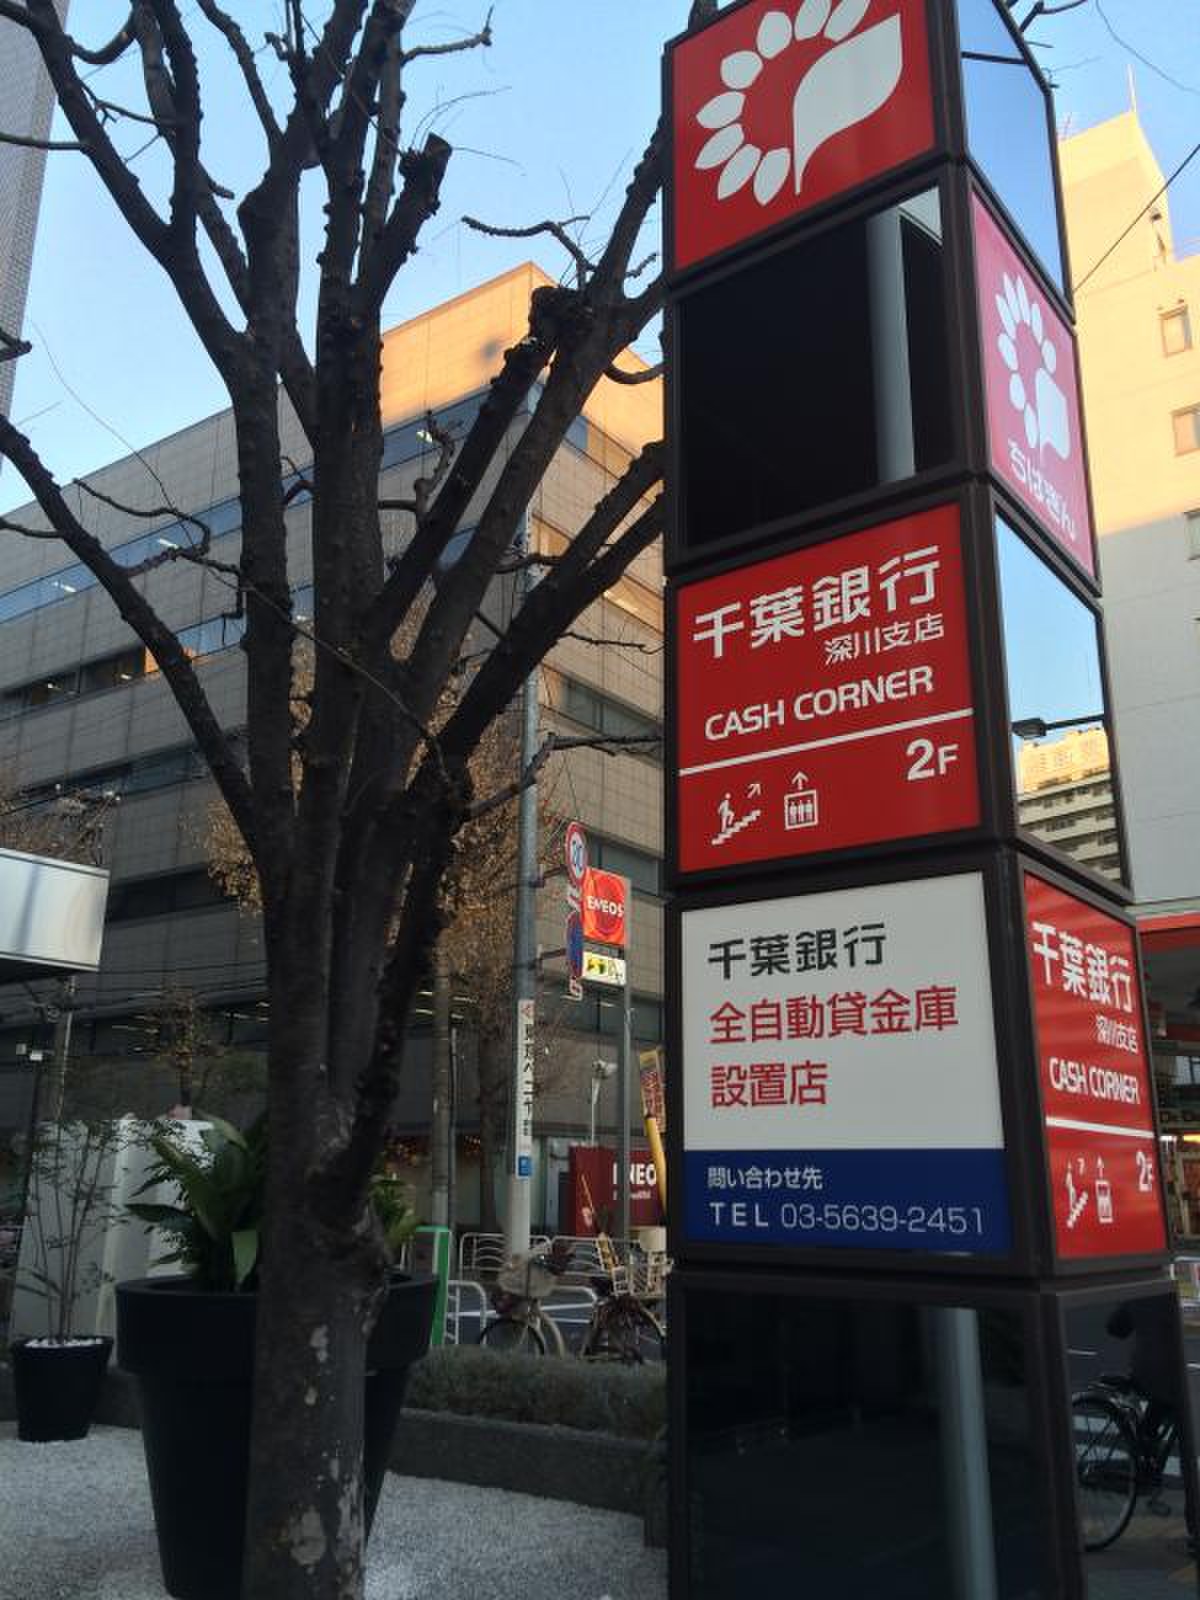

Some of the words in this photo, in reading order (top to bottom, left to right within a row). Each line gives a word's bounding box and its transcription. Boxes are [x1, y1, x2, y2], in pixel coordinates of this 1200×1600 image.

[693, 545, 940, 658] 千葉銀行
[824, 613, 945, 665] 深川支店
[704, 699, 785, 741] CASH
[793, 664, 935, 721] CORNER
[905, 738, 959, 781] 2F
[708, 922, 887, 980] 千葉銀行
[1031, 921, 1133, 1014] 千葉銀行
[709, 985, 960, 1044] 全自動貸金庫
[711, 1060, 829, 1109] 設置店
[1049, 1057, 1088, 1095] CASH
[1089, 1066, 1141, 1105] CORNER
[707, 1166, 824, 1190] 問い合わせ先
[709, 1202, 769, 1228] TEL
[781, 1202, 984, 1235] 03-5639-2451
